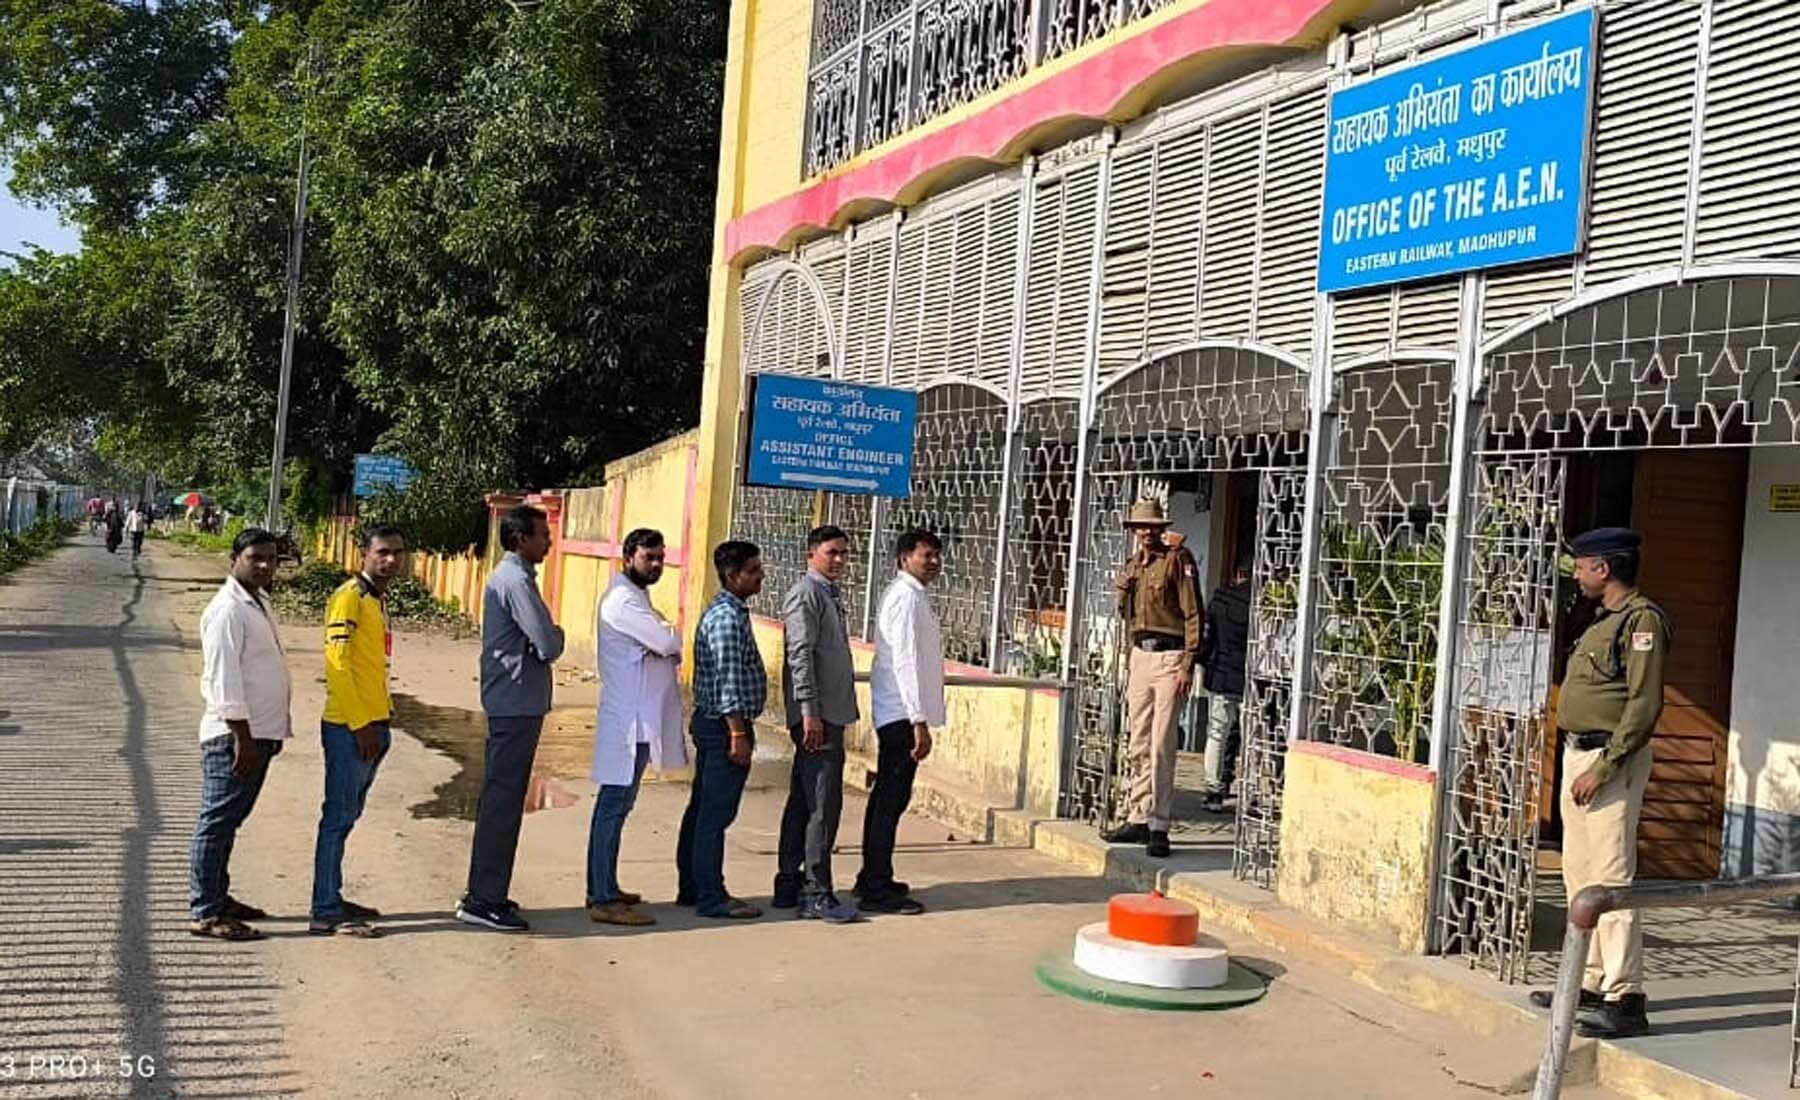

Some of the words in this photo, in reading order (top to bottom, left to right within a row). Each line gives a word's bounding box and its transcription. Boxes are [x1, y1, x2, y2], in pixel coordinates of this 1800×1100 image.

[1332, 104, 1390, 154] सहायक
[1393, 77, 1461, 138] अभियंता
[1471, 73, 1497, 116] का
[1501, 41, 1583, 108] कार्यालय
[1385, 152, 1407, 182] पूर्व
[1457, 128, 1508, 162] मधुपुर
[1332, 195, 1402, 245] OFFICE
[1408, 187, 1437, 230] OF
[1444, 176, 1487, 223] THE
[1492, 161, 1564, 212] A.E.N.
[1346, 251, 1397, 274] EASTERN
[1459, 225, 1536, 254] MADHUPUR
[772, 395, 832, 414] सहायक
[760, 439, 833, 458] ASSISTANT
[838, 447, 904, 466] ENGINEER
[814, 432, 855, 447] OFFICE
